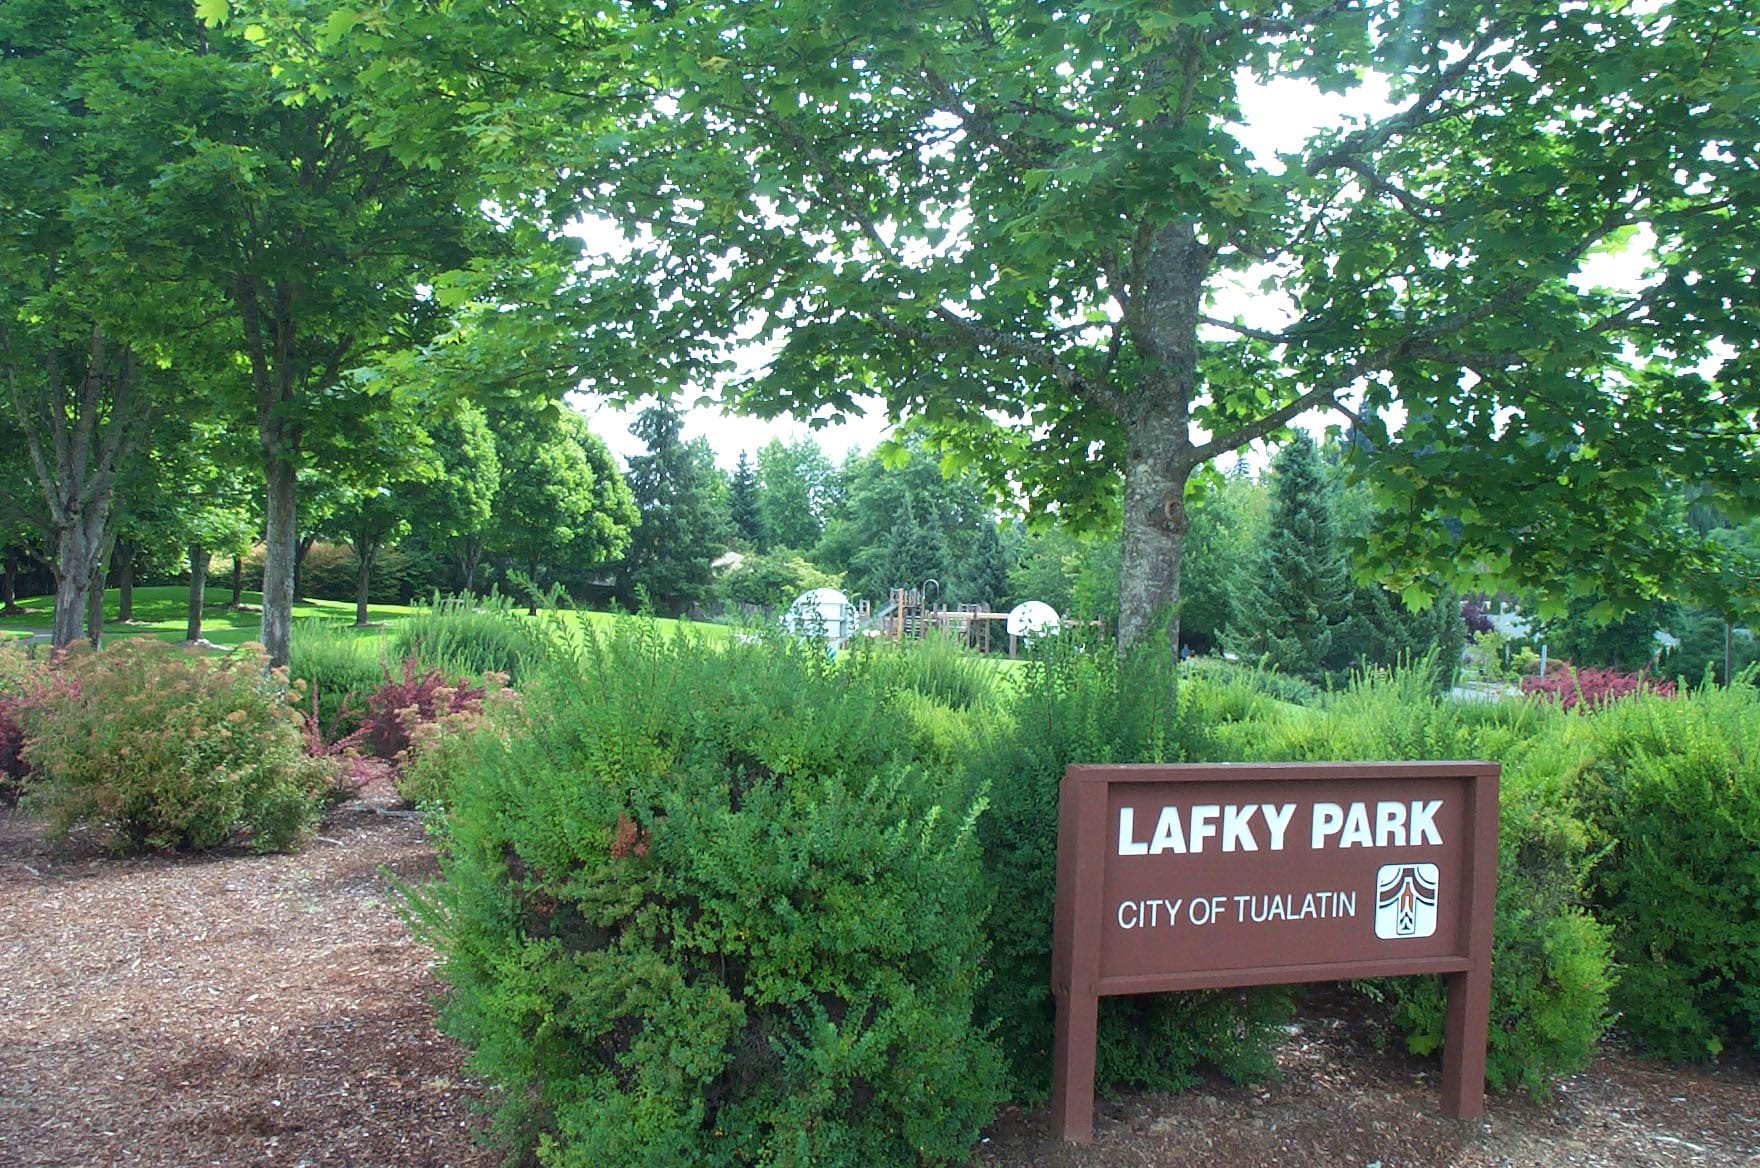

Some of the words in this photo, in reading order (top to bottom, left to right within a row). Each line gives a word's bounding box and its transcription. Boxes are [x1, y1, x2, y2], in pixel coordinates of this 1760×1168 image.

[1118, 803, 1297, 855] LAFKY
[1311, 800, 1444, 849] PARK
[1117, 898, 1183, 929] CITY
[1189, 896, 1227, 925] OF
[1233, 891, 1356, 923] TUALATIN
